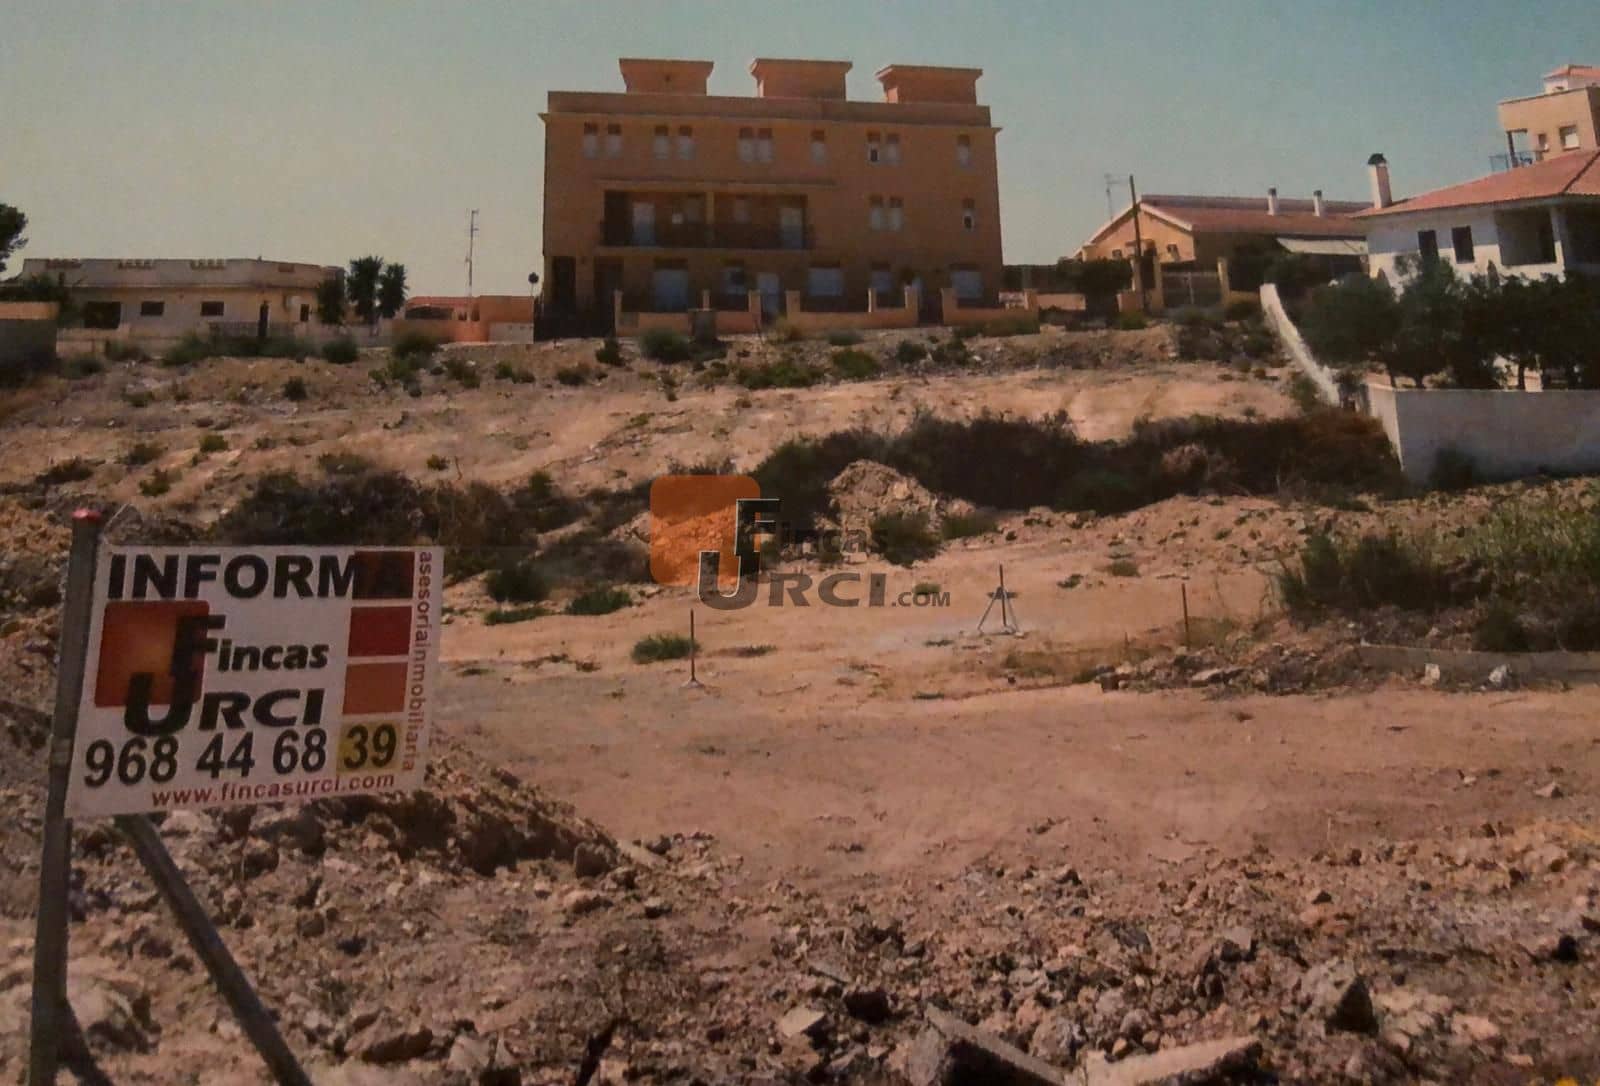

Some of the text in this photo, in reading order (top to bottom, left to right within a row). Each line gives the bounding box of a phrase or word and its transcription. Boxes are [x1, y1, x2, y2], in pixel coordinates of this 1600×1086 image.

[171, 614, 330, 680] Fincas
[124, 672, 325, 736] URCI
[84, 723, 397, 788] 968 44 68 39
[151, 773, 395, 807] www.fincasurci.com
